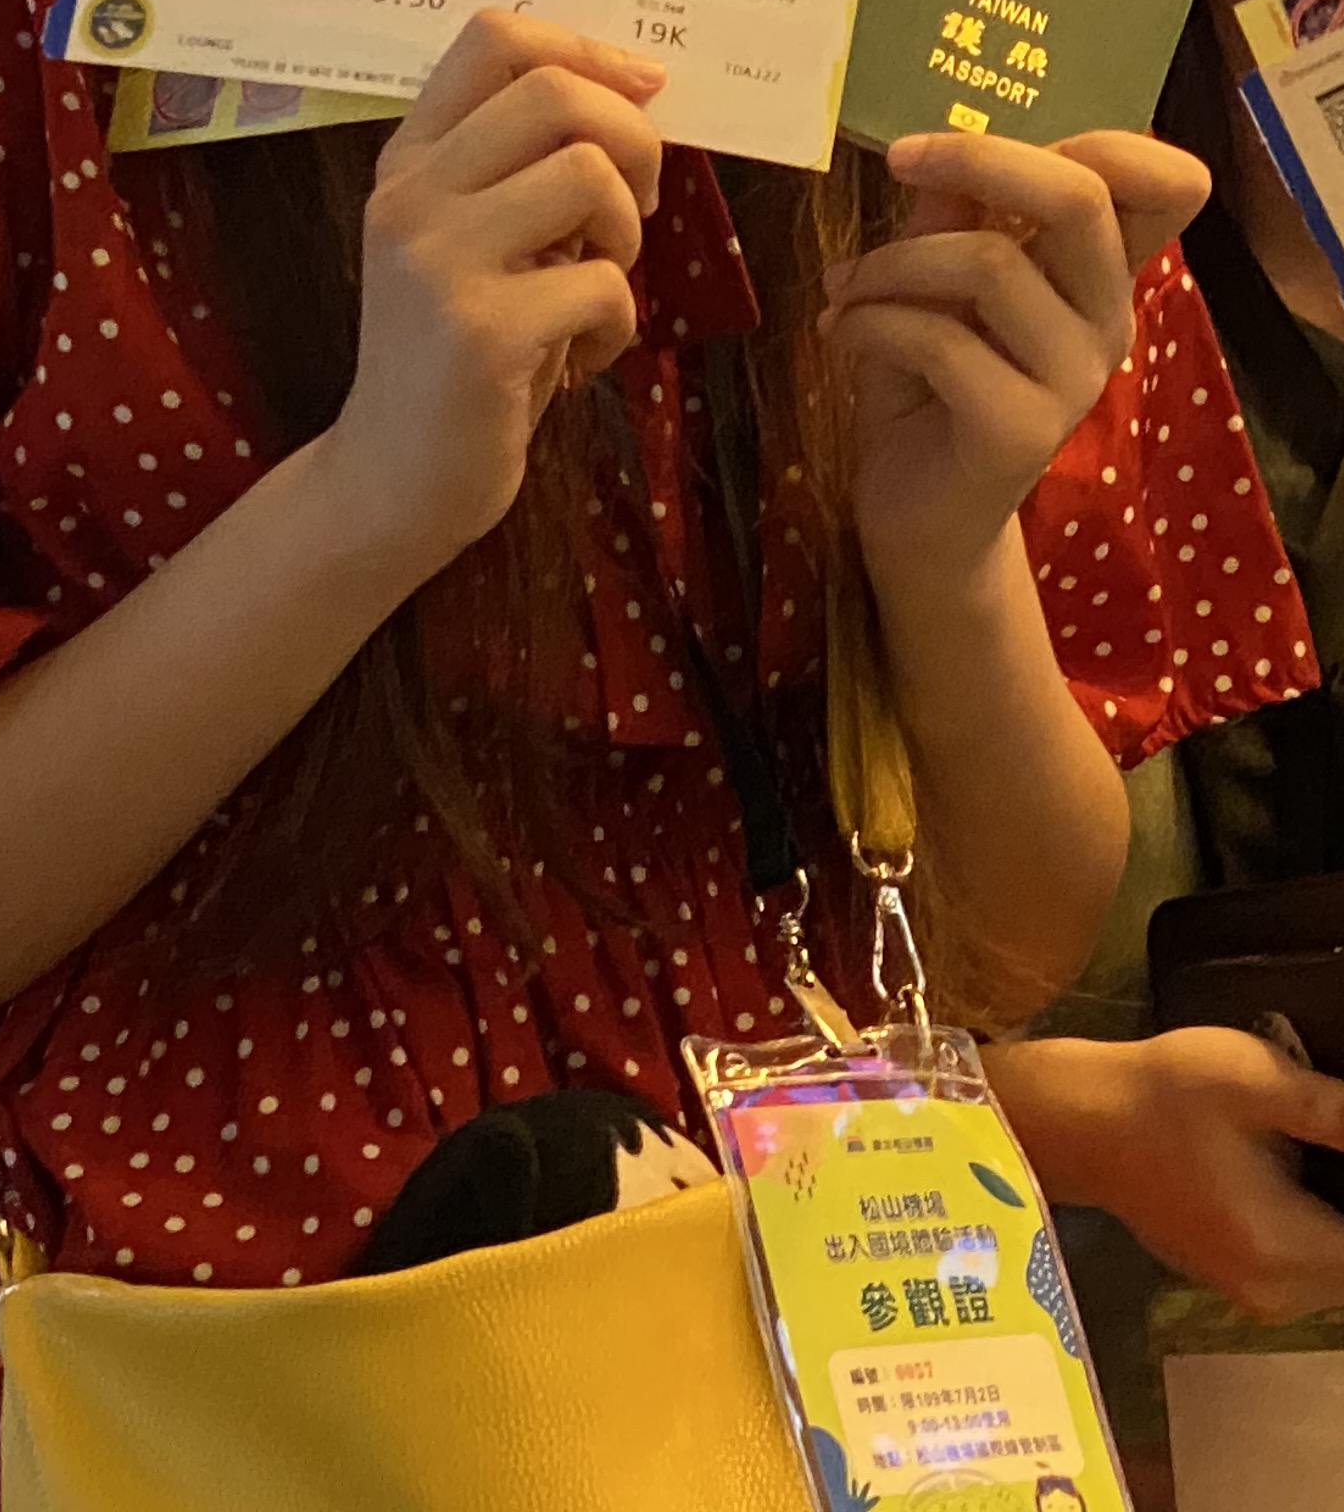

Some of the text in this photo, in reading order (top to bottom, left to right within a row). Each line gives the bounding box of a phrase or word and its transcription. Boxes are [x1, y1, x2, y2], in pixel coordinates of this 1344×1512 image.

[631, 18, 689, 48] 19K
[942, 12, 1049, 78] 護照
[928, 48, 1040, 109] PASSPORT
[859, 1190, 949, 1224] 松山機場
[860, 1274, 995, 1332] 參觀證
